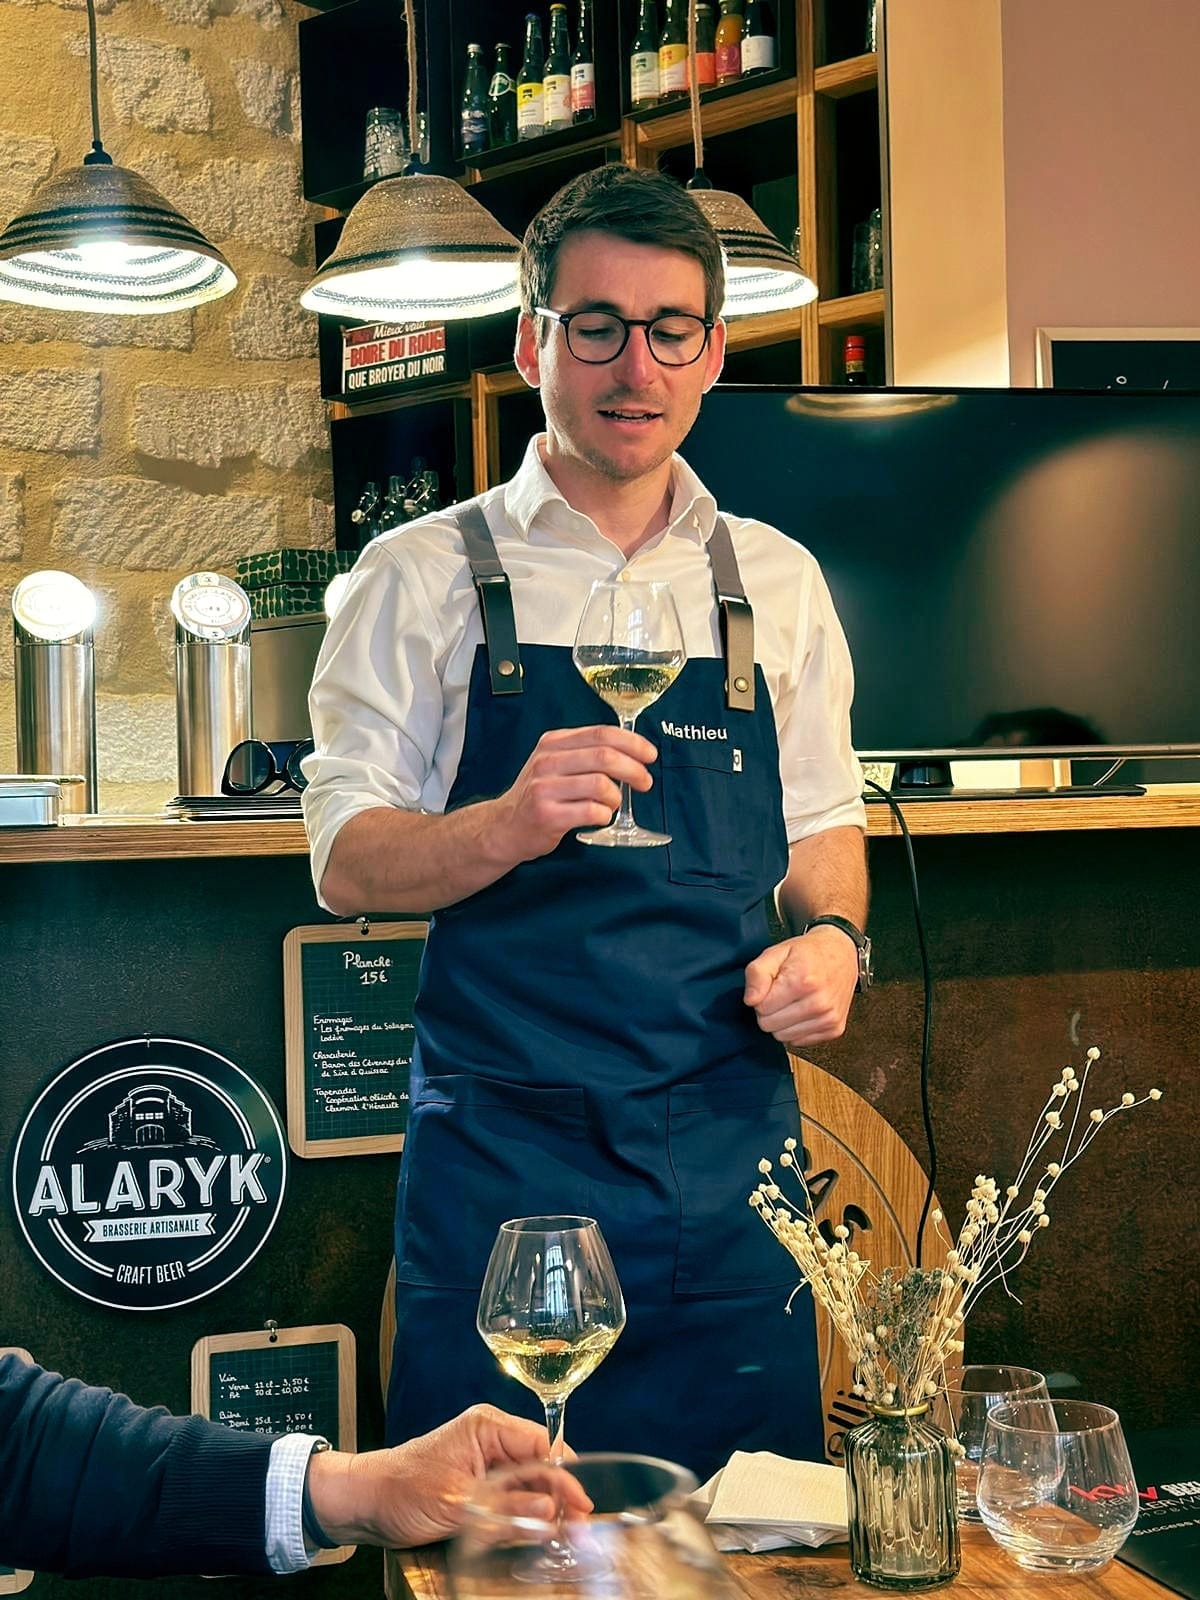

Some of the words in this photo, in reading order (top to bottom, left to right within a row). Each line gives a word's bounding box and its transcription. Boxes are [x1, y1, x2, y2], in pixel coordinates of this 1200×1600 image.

[373, 324, 403, 339] Mieux
[350, 341, 386, 368] BOIRE
[388, 338, 406, 361] DU
[408, 329, 445, 356] ROUG
[348, 371, 367, 389] QUE
[368, 363, 406, 386] BROYER
[407, 360, 421, 378] DU
[422, 355, 444, 375] NOIR
[661, 720, 728, 740] Mathieu
[342, 951, 391, 969] Planche
[360, 970, 388, 985] 15€
[28, 1152, 269, 1216] ALARYK
[102, 1222, 147, 1237] BRASSERIE
[150, 1218, 200, 1234] ARTISANALE
[116, 1263, 153, 1285] CRAFT
[156, 1261, 186, 1284] BEER
[218, 1372, 237, 1383] Vin
